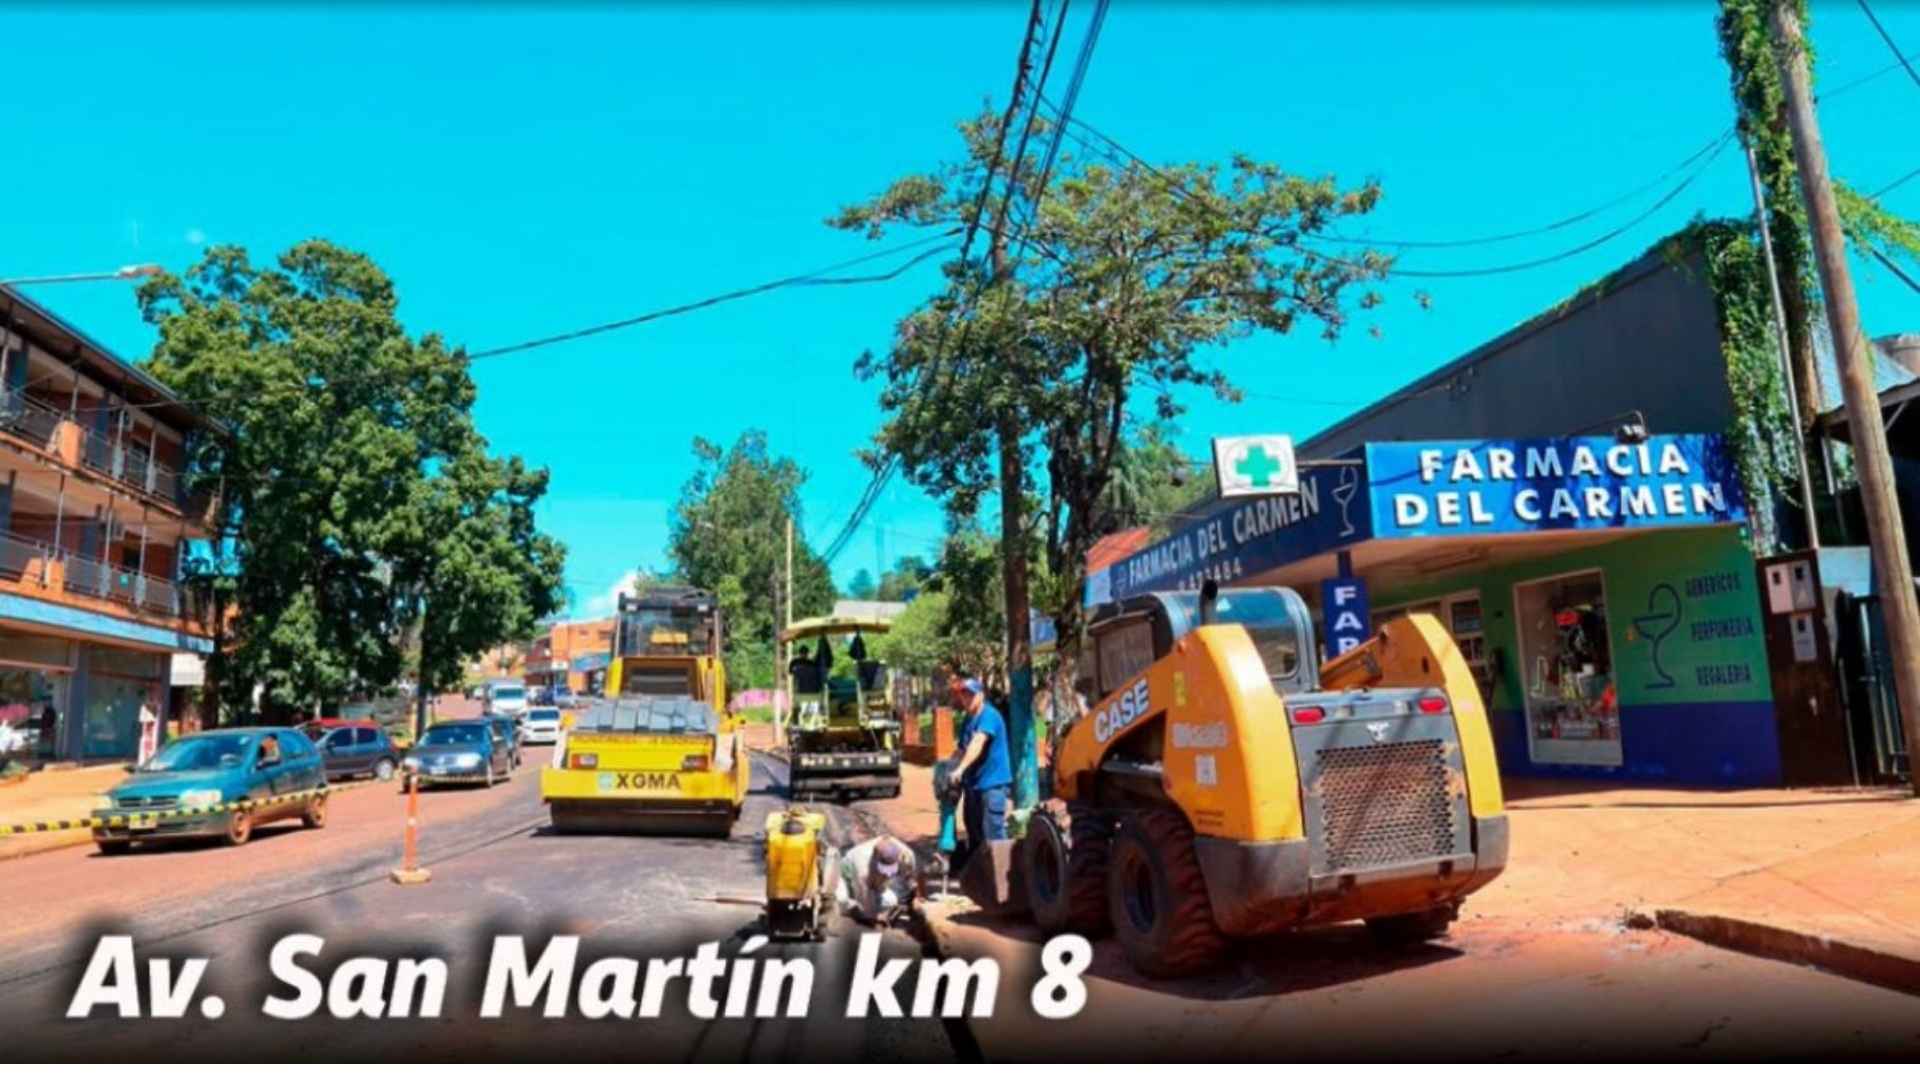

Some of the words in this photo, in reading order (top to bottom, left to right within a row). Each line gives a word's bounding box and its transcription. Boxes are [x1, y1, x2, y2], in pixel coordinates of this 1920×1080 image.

[1128, 534, 1193, 588] FARMACIA
[1197, 519, 1228, 560] DEL
[1232, 476, 1320, 544] CARMEN
[1393, 490, 1495, 527] DEL
[1513, 481, 1727, 521] CARMEN
[1094, 677, 1150, 743] CASE
[616, 772, 682, 790] XGMA
